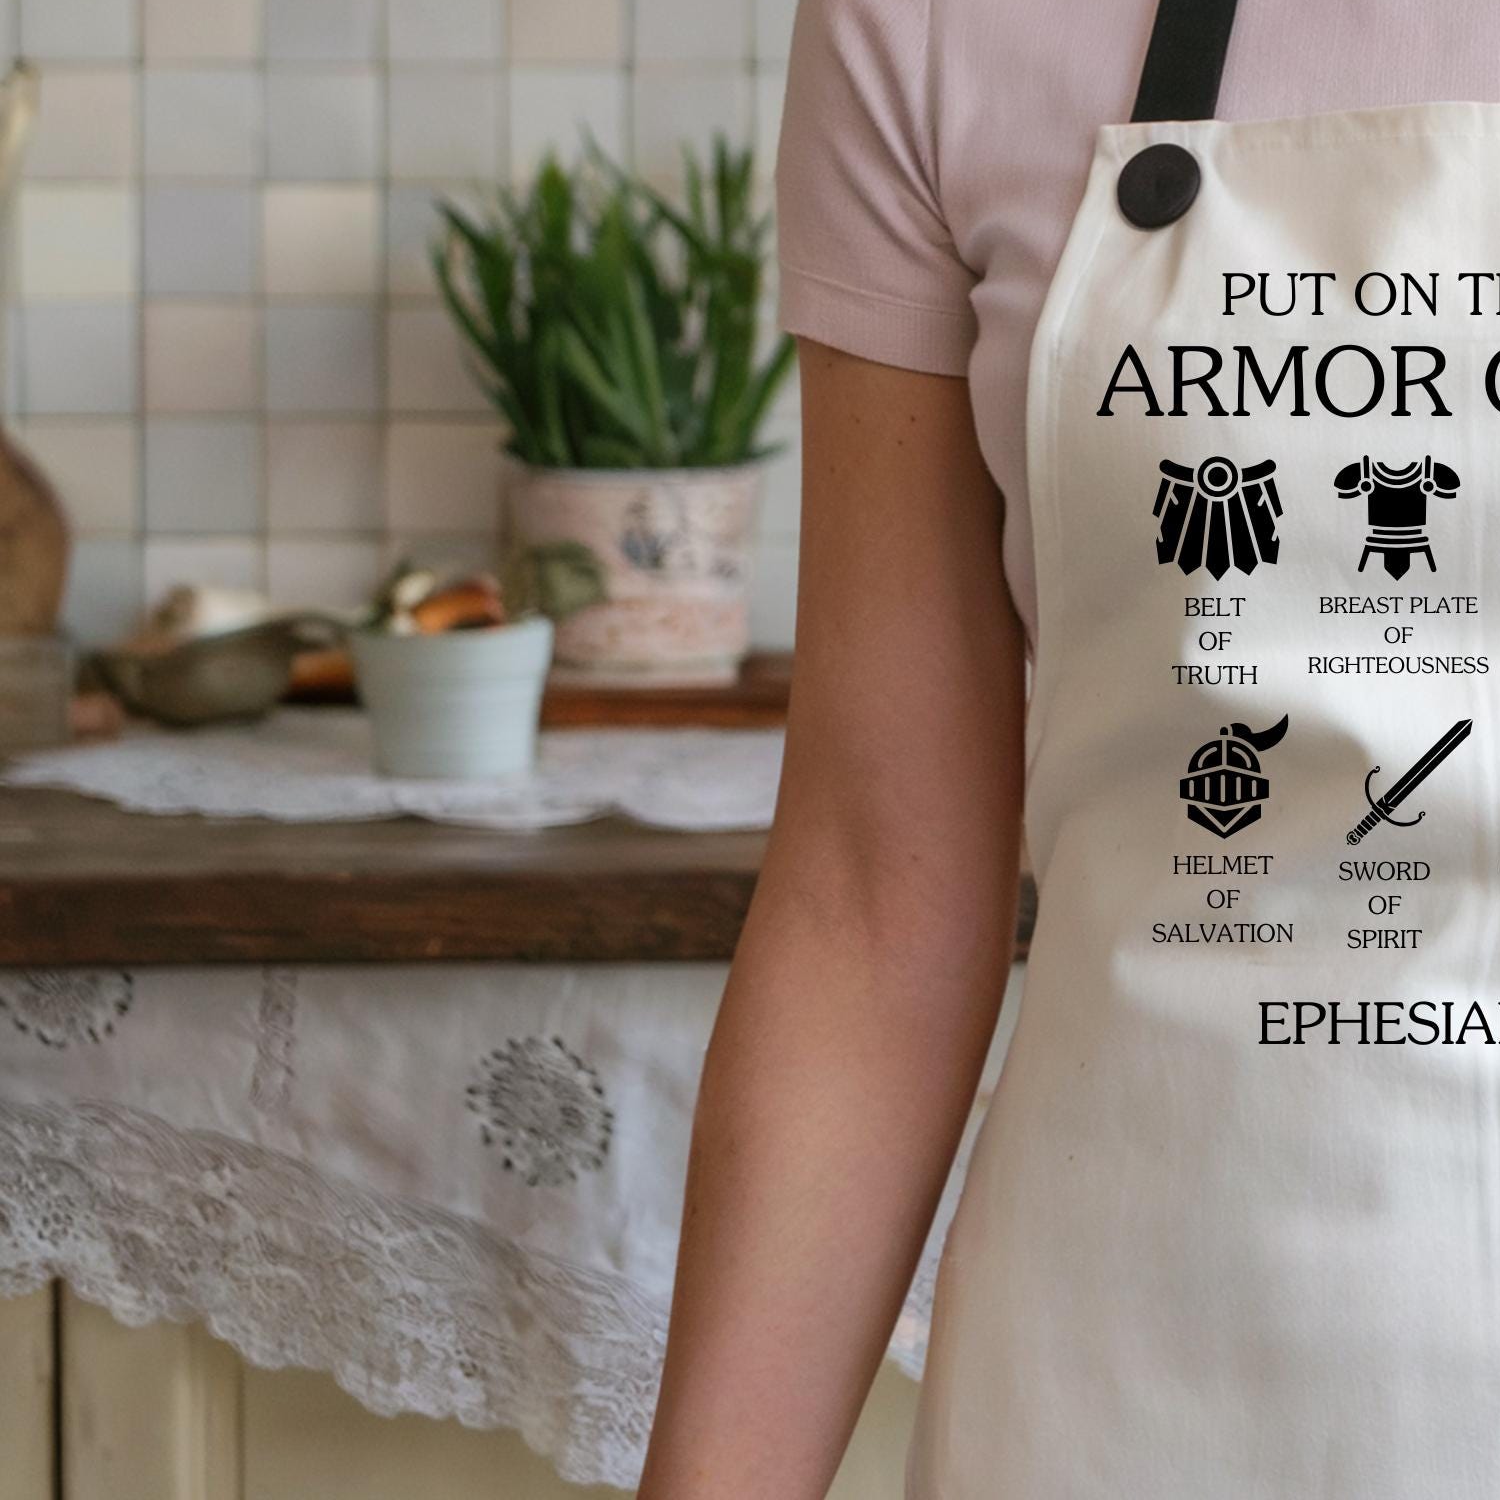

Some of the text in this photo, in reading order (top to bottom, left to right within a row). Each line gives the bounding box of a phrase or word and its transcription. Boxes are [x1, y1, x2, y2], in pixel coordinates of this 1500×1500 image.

[1221, 272, 1337, 317] PUT
[1354, 271, 1440, 317] ON
[1095, 343, 1453, 419] ARMOR
[1183, 597, 1247, 617] BELT
[1319, 596, 1479, 614] BREAST PLATE
[1198, 631, 1233, 651] OF
[1383, 626, 1414, 644] OF
[1169, 663, 1258, 686] TRUTH
[1307, 656, 1490, 674] RIGHTEOUSNESS
[1172, 855, 1274, 875] HELMET
[1338, 861, 1431, 882] SWORD
[1206, 889, 1241, 909] OF
[1368, 895, 1402, 915] OF
[1151, 923, 1294, 944] SALVATION
[1347, 929, 1423, 949] SPIRIT
